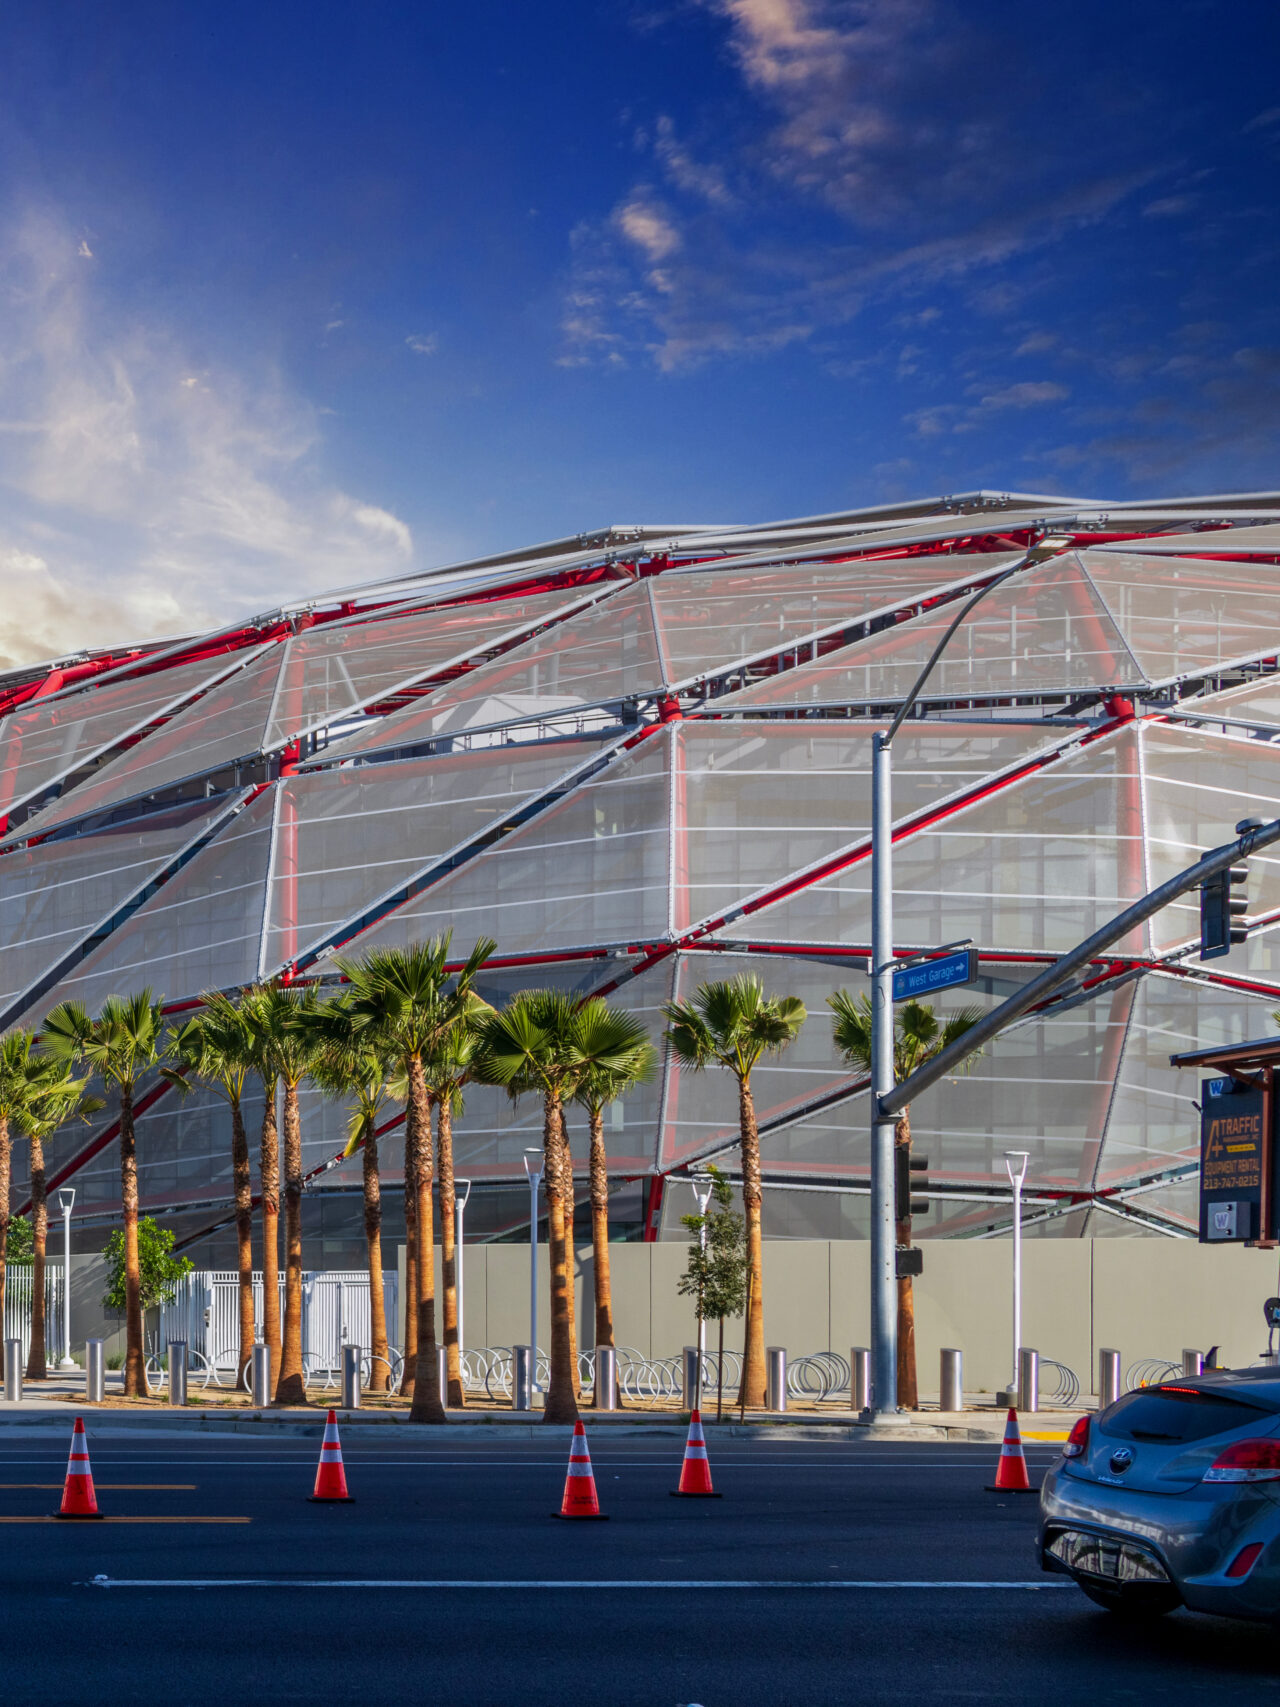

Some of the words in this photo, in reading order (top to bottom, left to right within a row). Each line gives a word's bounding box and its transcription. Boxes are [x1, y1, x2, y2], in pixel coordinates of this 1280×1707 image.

[909, 973, 927, 988] West
[928, 966, 955, 982] Garage
[1220, 1115, 1260, 1135] TRAFFIC
